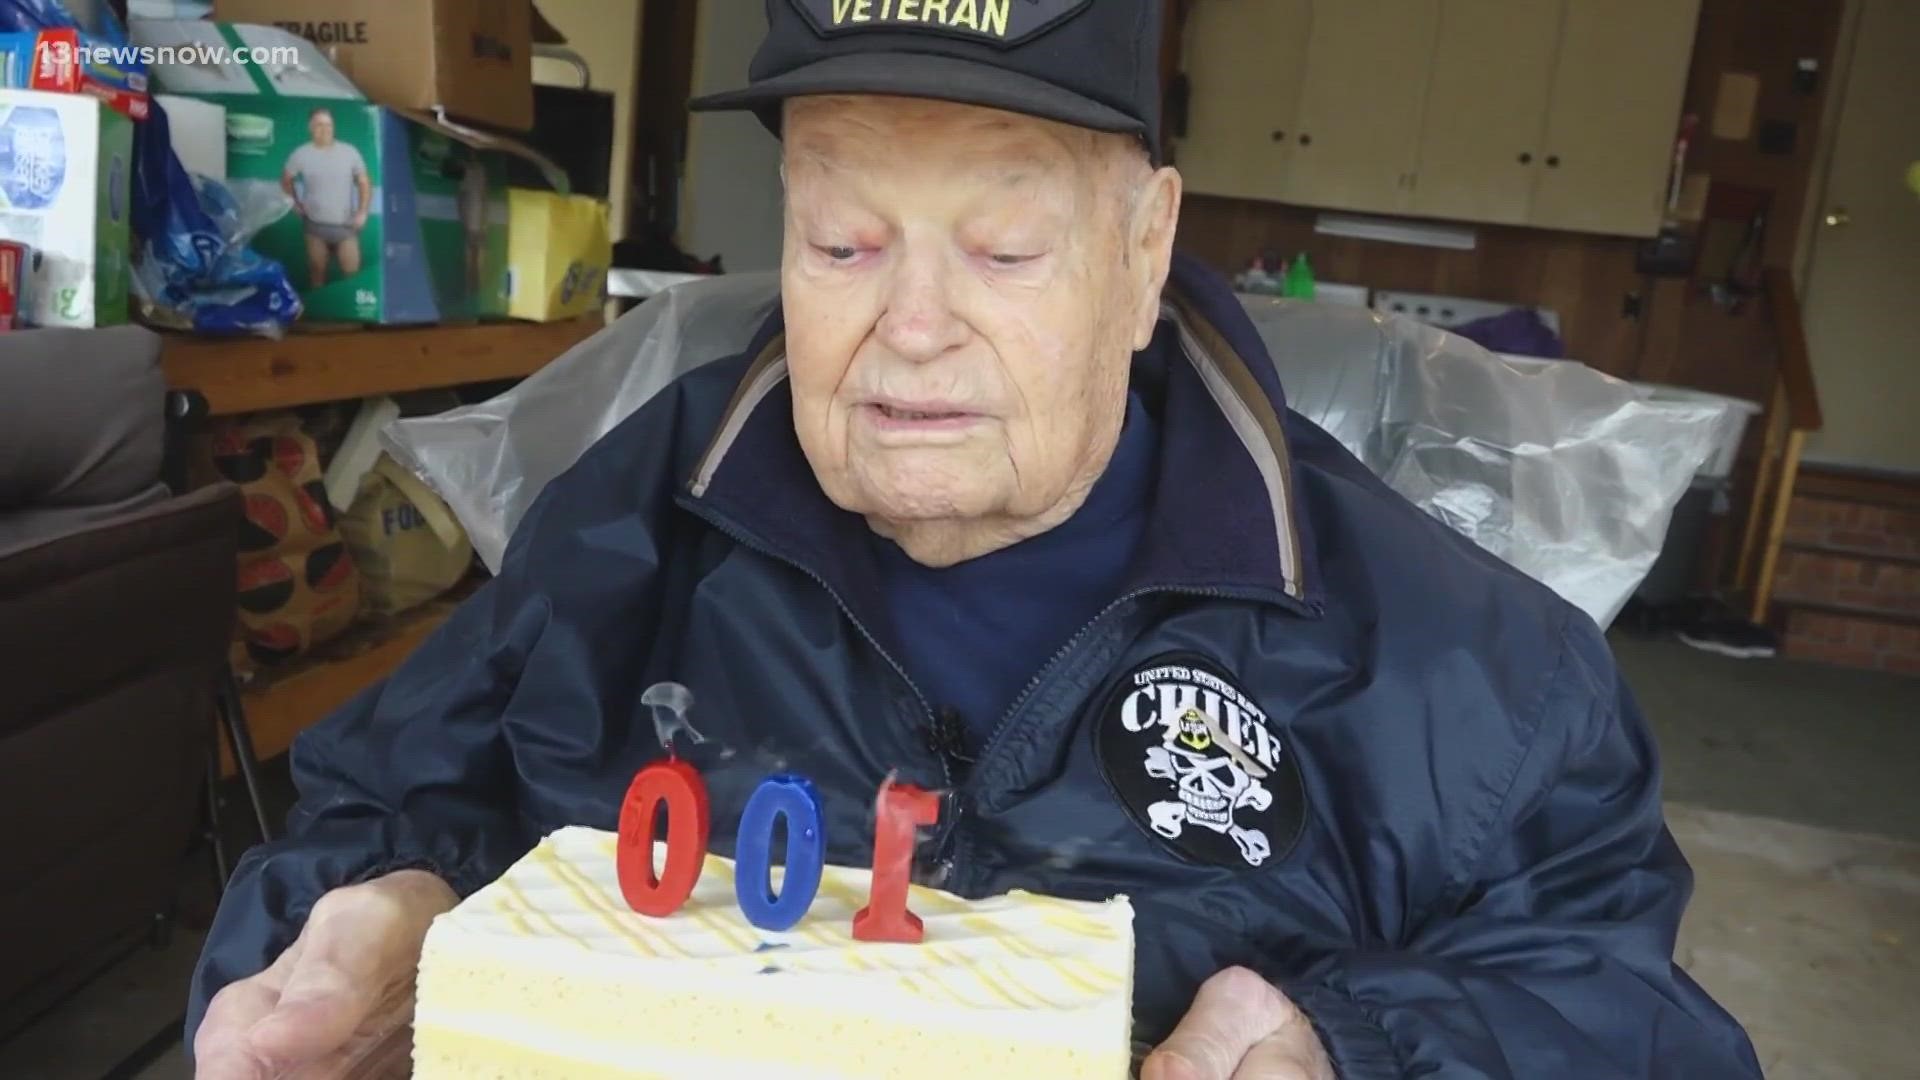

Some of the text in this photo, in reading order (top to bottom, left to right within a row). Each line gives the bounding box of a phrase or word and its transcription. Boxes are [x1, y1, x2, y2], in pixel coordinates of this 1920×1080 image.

[273, 21, 368, 43] RAGILE
[831, 0, 1010, 36] VETERAN
[1133, 665, 1191, 685] UNITED
[1191, 668, 1237, 701] STATES
[1120, 682, 1282, 772] CHIEF
